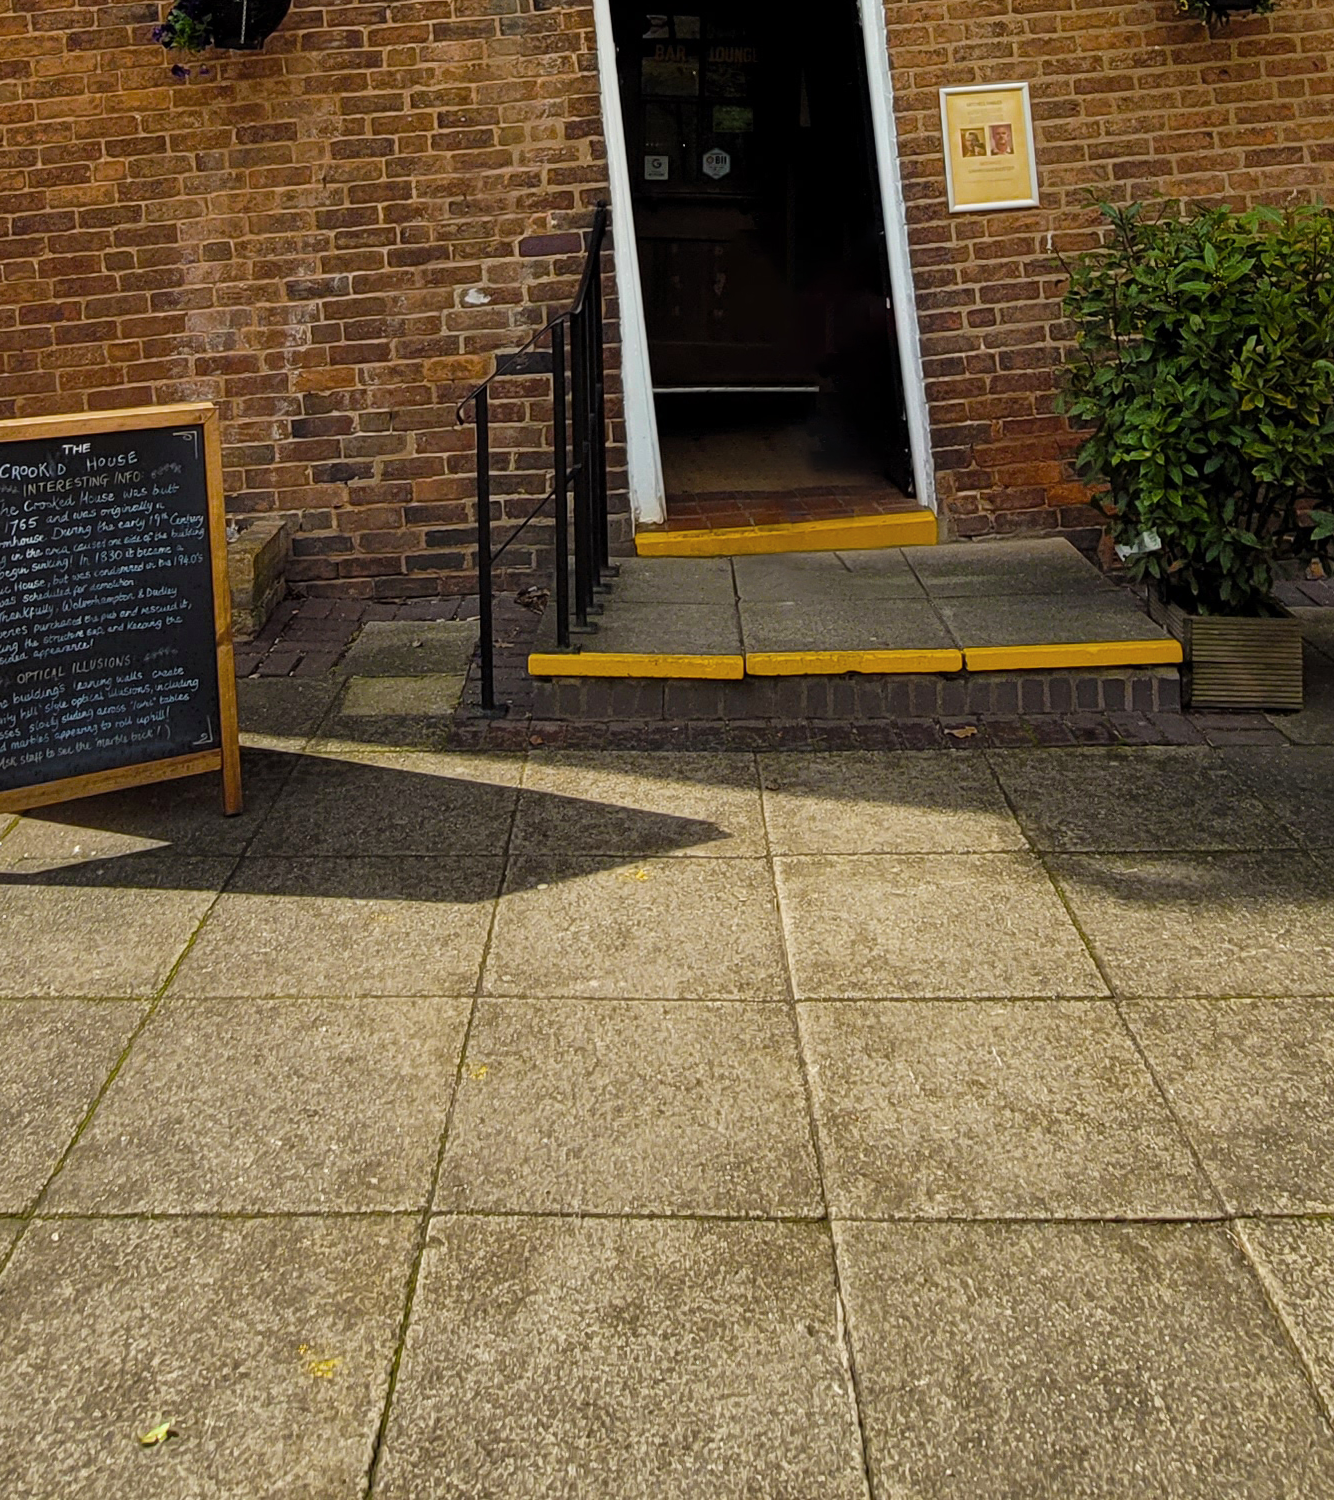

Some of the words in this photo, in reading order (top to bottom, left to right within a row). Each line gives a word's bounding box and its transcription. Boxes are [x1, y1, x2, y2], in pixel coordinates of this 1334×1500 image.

[63, 443, 91, 455] THE
[86, 451, 138, 472] HOUSE
[23, 473, 109, 496] INTERESTING
[24, 494, 75, 512] Crooked
[80, 491, 115, 505] House
[123, 488, 148, 499] was
[5, 516, 39, 536] 1765
[46, 510, 70, 523] and
[73, 509, 97, 519] was
[100, 500, 153, 518] originally
[51, 522, 92, 539] During
[97, 521, 115, 532] the
[118, 517, 145, 531] early
[11, 549, 23, 561] in
[26, 548, 43, 558] the
[108, 538, 122, 546] one
[143, 532, 153, 543] of
[154, 531, 167, 540] the
[79, 554, 89, 565] In
[95, 550, 122, 563] 1830
[126, 549, 135, 557] it
[137, 545, 172, 557] became
[53, 574, 69, 585] but
[72, 571, 91, 580] was
[158, 558, 172, 567] the
[22, 586, 72, 603] scheduled
[72, 583, 87, 596] for
[90, 578, 135, 591] demolition
[137, 589, 145, 598] &
[146, 585, 178, 599] Dudley
[33, 616, 82, 633] purchased
[84, 614, 99, 623] the
[100, 610, 117, 622] pub
[119, 606, 138, 617] and
[140, 603, 178, 615] rescued
[24, 638, 39, 648] the
[42, 629, 85, 644] structure
[107, 622, 124, 633] and
[165, 616, 183, 625] the
[16, 666, 65, 684] OPTICAL
[152, 666, 184, 678] create
[71, 691, 104, 708] optical
[155, 678, 199, 692] including
[97, 704, 126, 716] across
[159, 693, 190, 705] tables
[11, 733, 49, 750] marbles
[54, 722, 98, 740] appearing
[101, 720, 112, 730] to
[20, 750, 44, 764] staff
[46, 748, 55, 758] to
[57, 745, 74, 756] see
[75, 741, 92, 753] the
